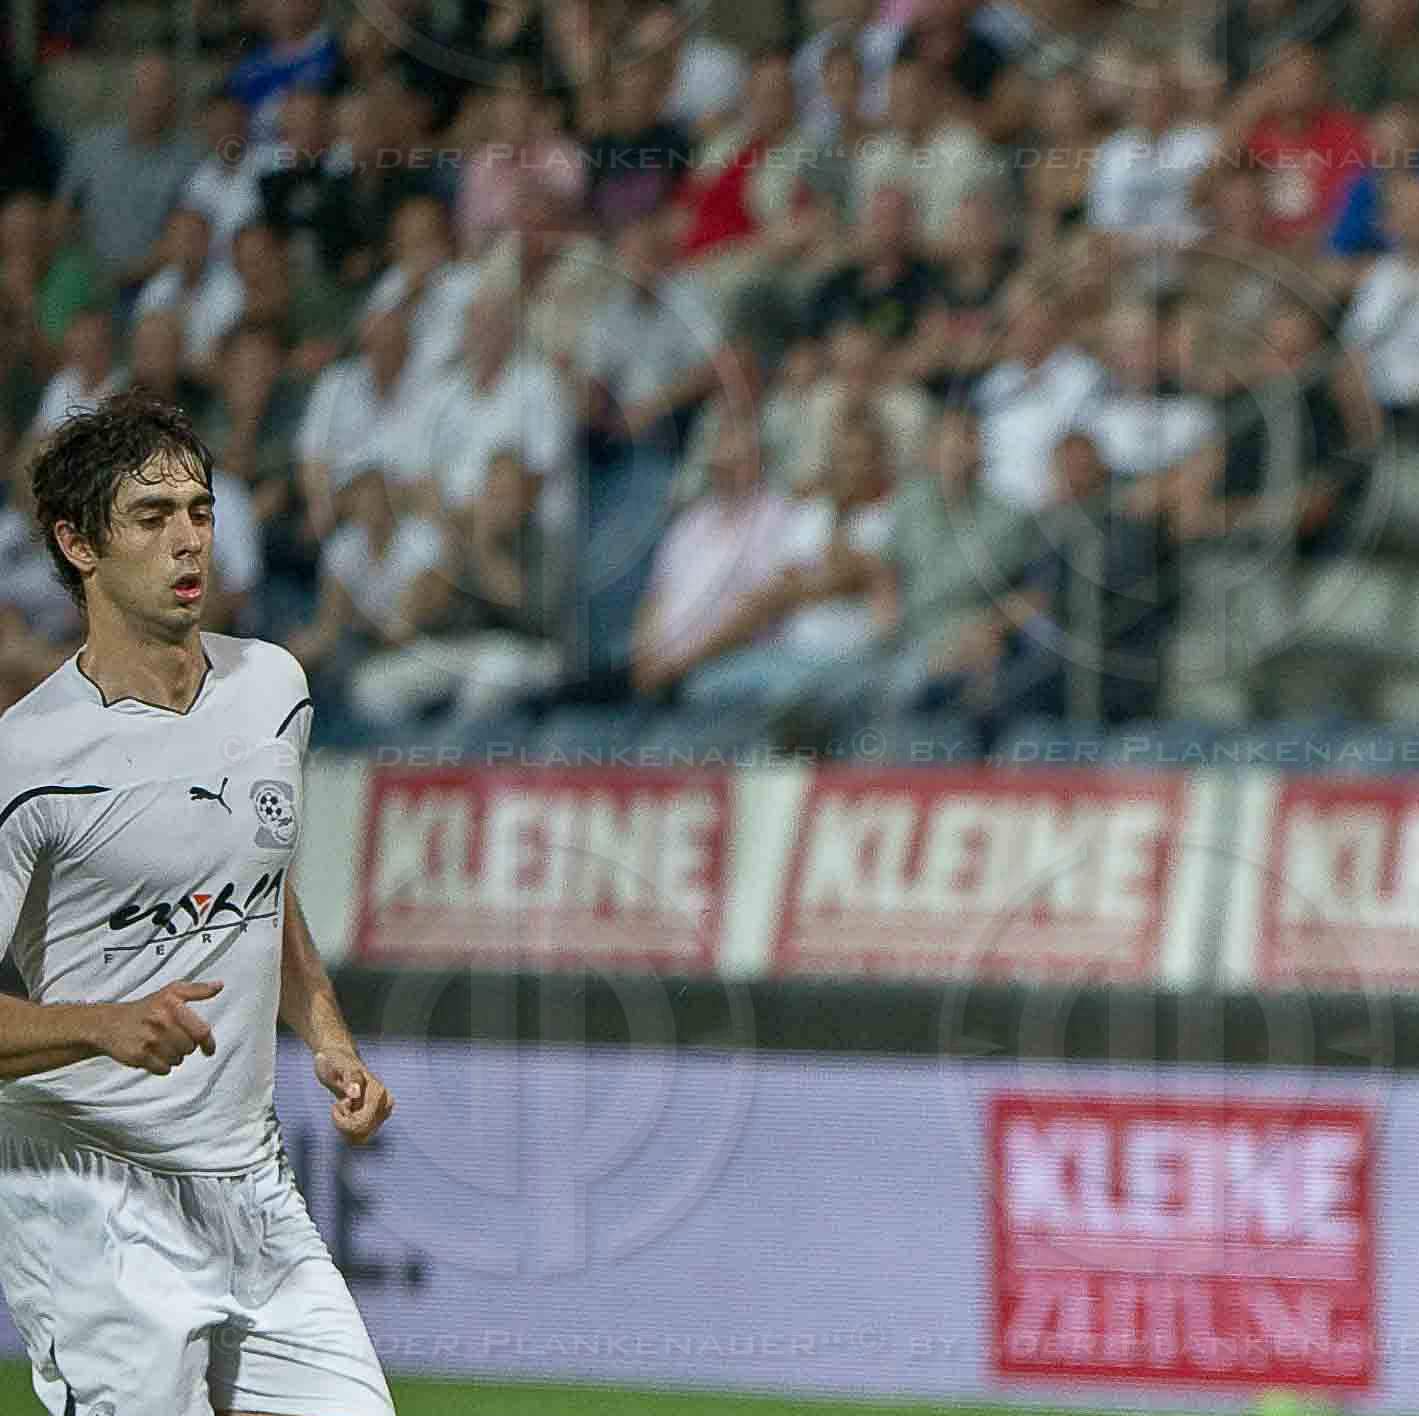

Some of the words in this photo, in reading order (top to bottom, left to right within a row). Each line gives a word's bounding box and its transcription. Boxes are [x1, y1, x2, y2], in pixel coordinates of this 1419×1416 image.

[372, 790, 714, 915] KLEINE
[803, 794, 1163, 923] KLEINE
[1003, 1118, 1366, 1242] KLEINE
